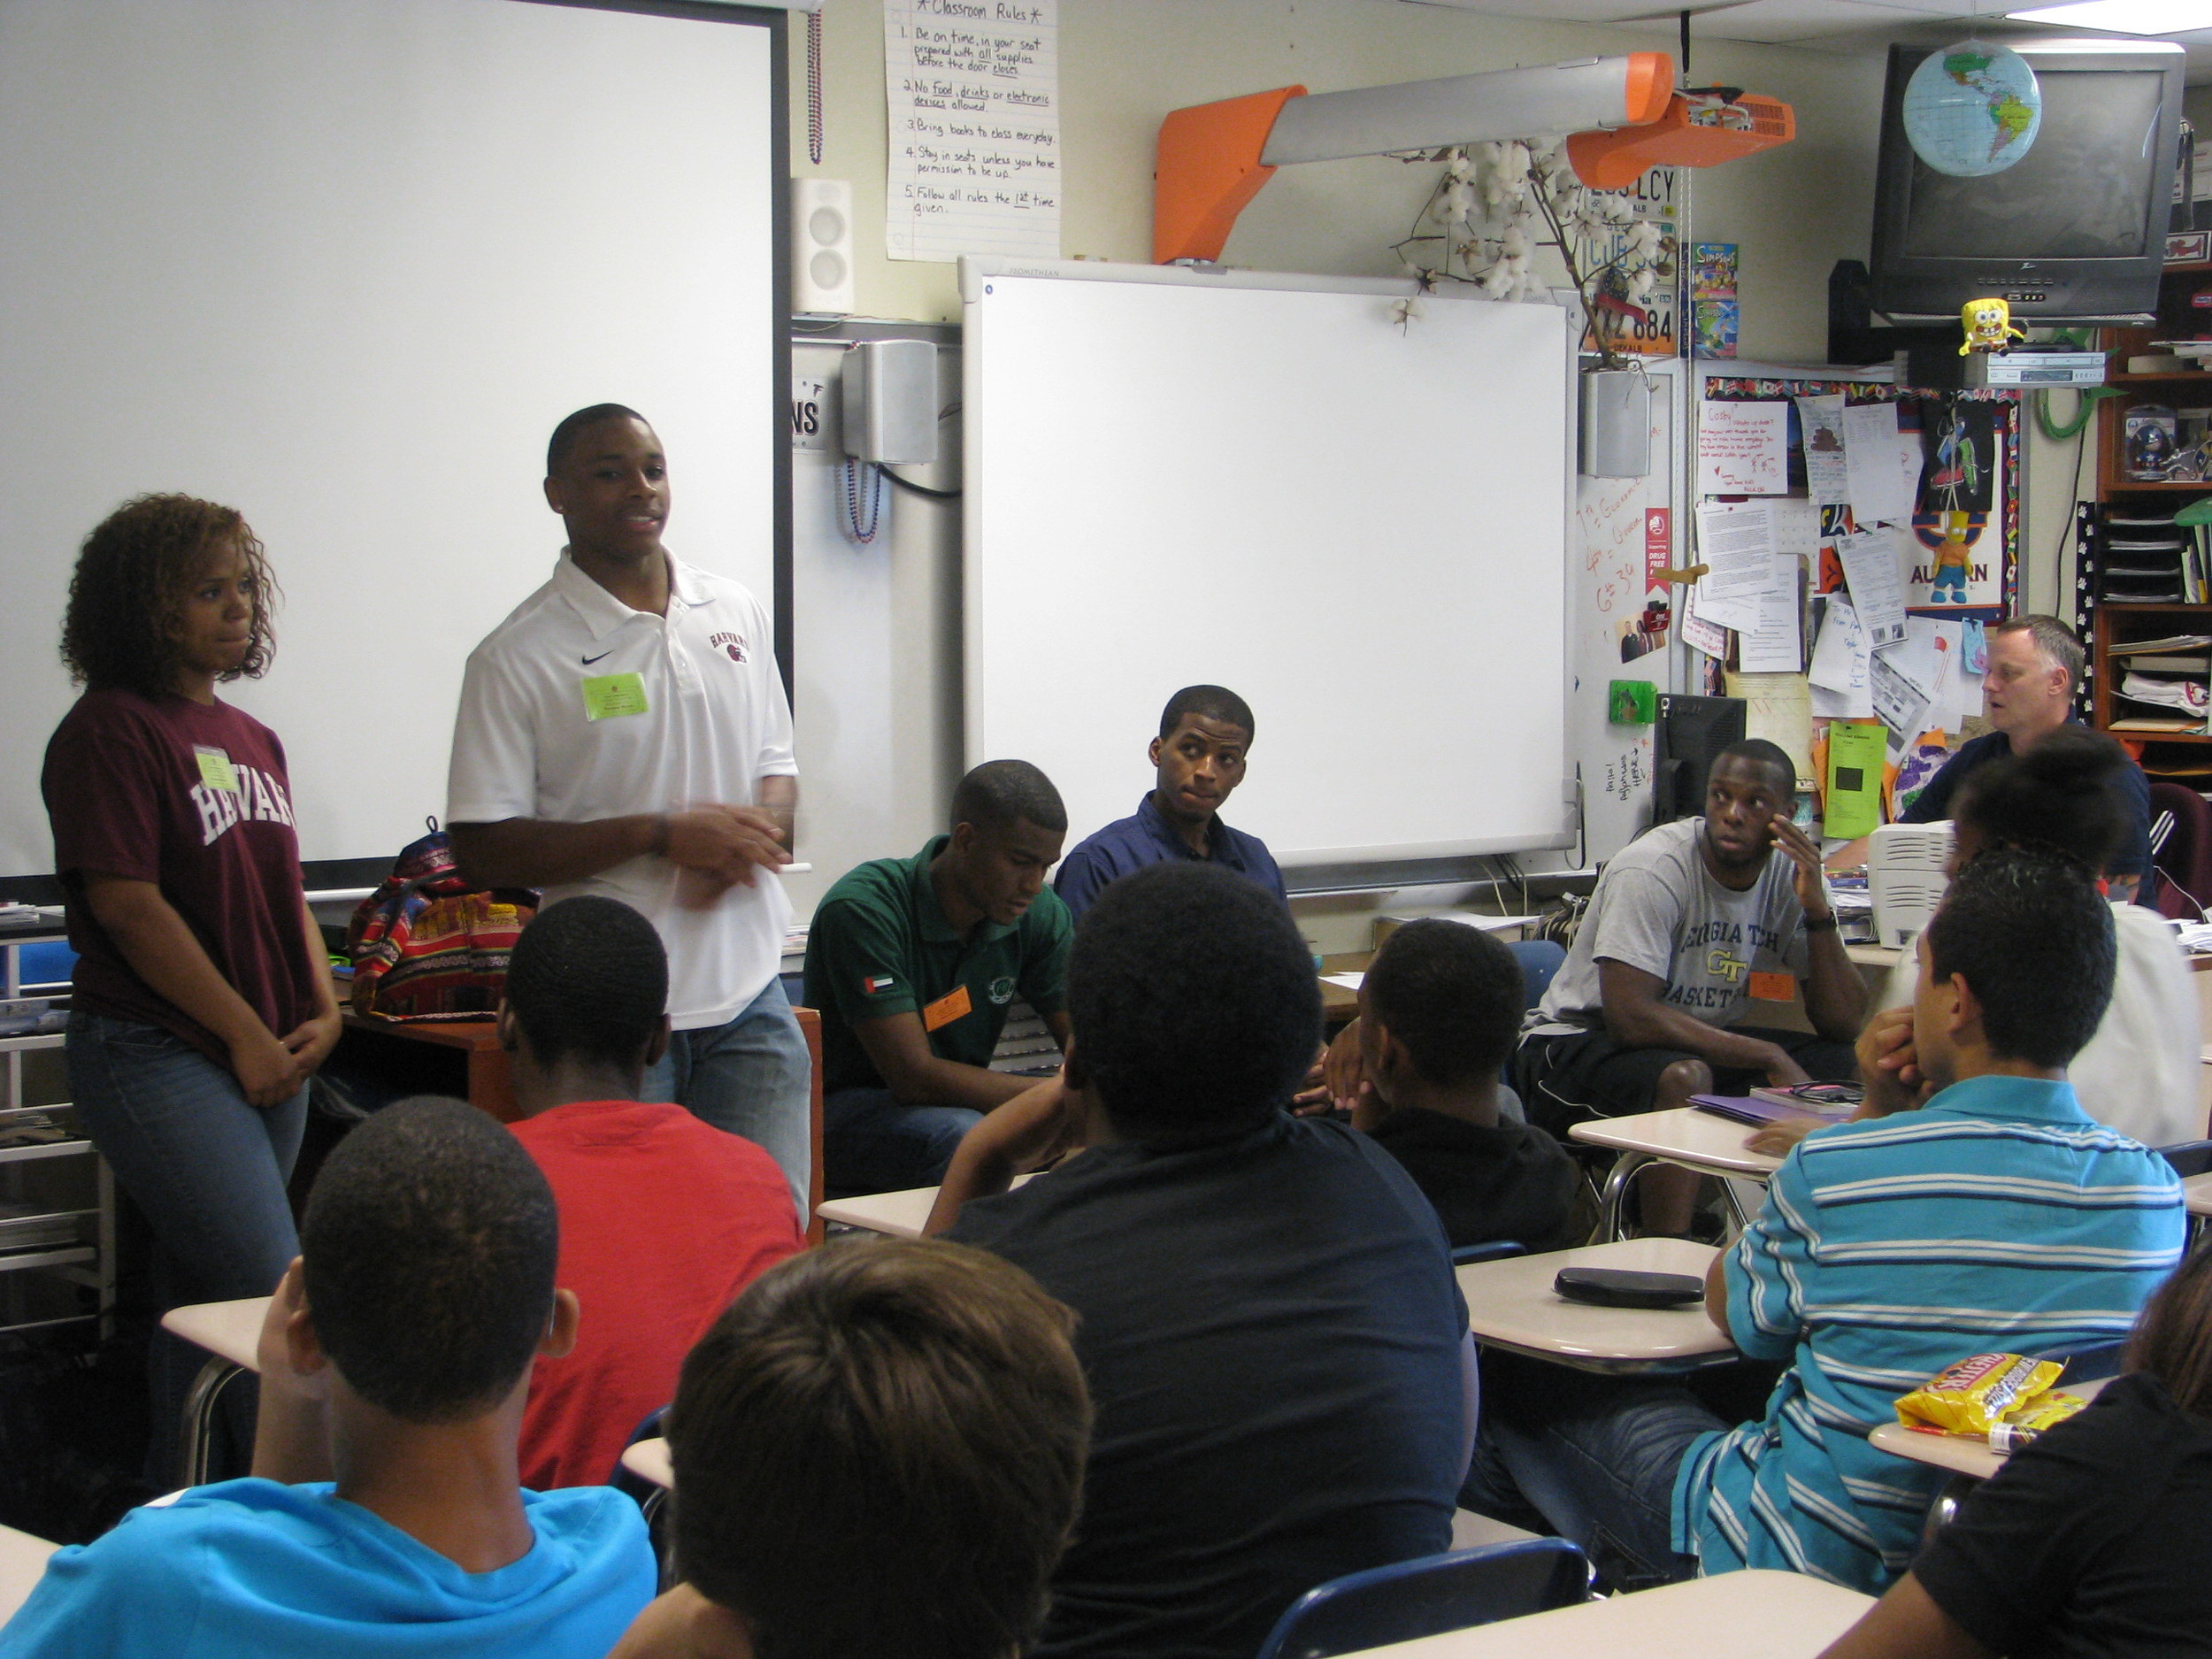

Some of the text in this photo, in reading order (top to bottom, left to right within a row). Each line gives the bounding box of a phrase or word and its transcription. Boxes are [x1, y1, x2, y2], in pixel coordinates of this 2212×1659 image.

[933, 0, 1026, 21] Classroom Rules
[916, 27, 929, 40] Be
[933, 33, 948, 42] on
[981, 37, 990, 46] in
[995, 39, 1014, 52] your
[1020, 38, 1041, 50] seat
[914, 44, 1033, 65] prepared with all supplies
[918, 55, 944, 68] before
[949, 58, 964, 70] the
[968, 60, 988, 72] door
[914, 80, 928, 93] No
[961, 86, 989, 99] drinks
[1007, 92, 1050, 104] electronic
[915, 96, 946, 108] devices
[917, 118, 944, 137] Bring
[950, 122, 974, 135] books
[979, 126, 987, 137] to
[992, 127, 1012, 139] class
[1017, 130, 1056, 146] everyday.
[918, 146, 939, 162] Stay
[942, 151, 950, 160] in
[955, 150, 976, 162] seats
[983, 152, 1010, 165] unless
[1015, 158, 1032, 170] you
[1036, 155, 1055, 169] have
[918, 163, 963, 174] permission
[967, 166, 976, 175] to
[981, 167, 991, 176] be
[917, 186, 945, 200] Follow
[949, 188, 961, 201] all
[967, 191, 988, 203] rules
[995, 192, 1010, 204] the
[1015, 192, 1029, 205] 1st
[1033, 192, 1055, 207] time
[1909, 564, 1987, 584] AUN
[190, 764, 296, 846] HAVAR
